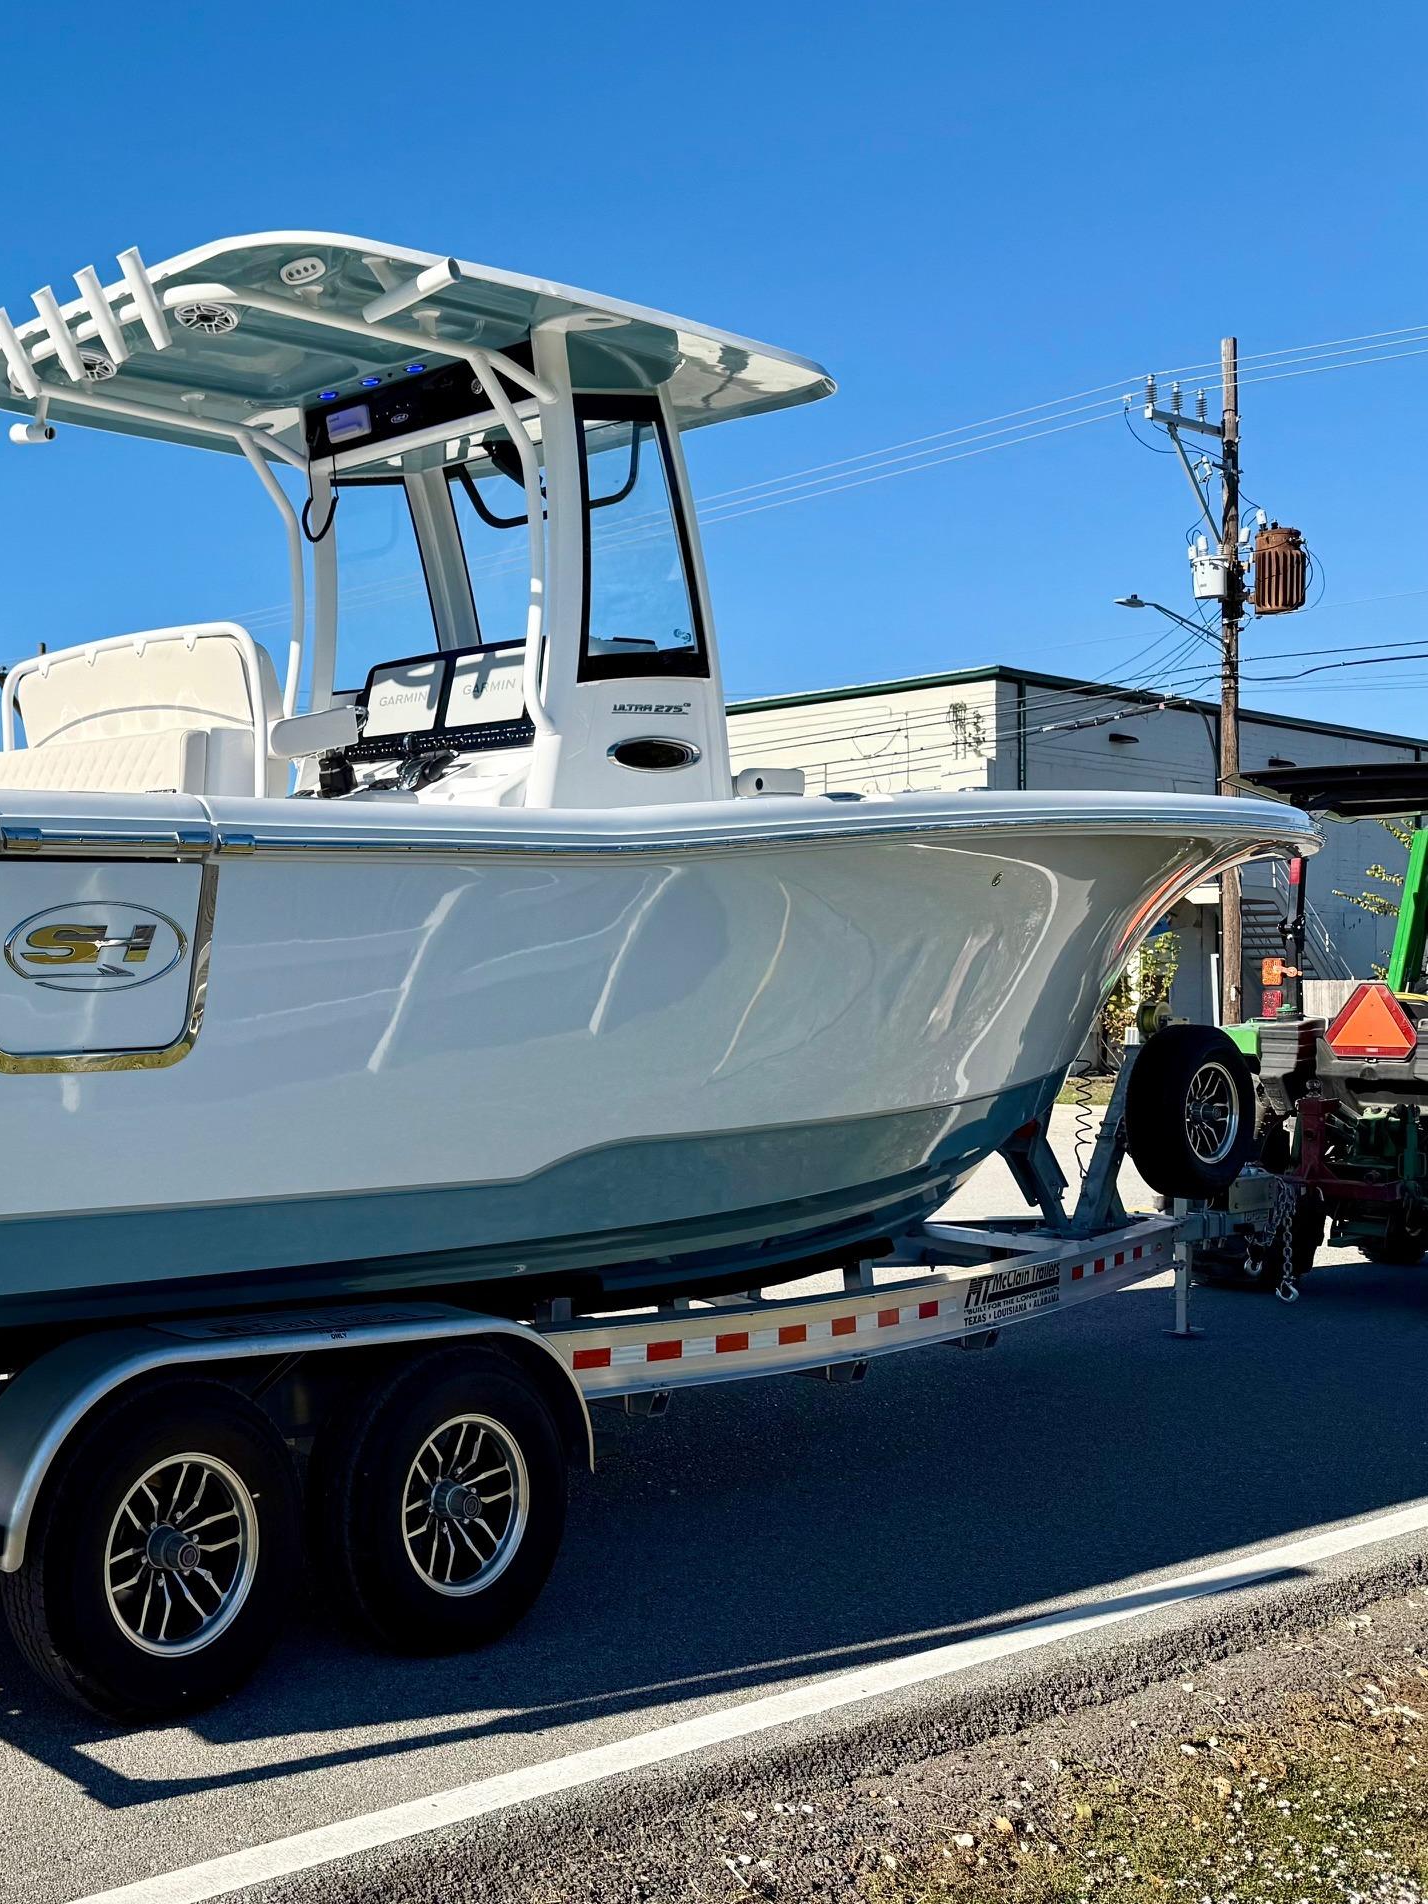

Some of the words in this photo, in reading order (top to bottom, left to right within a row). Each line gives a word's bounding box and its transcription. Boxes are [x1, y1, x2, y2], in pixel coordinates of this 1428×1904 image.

[463, 679, 516, 696] GARMIN
[379, 691, 428, 707] GARMIN
[613, 704, 652, 712] ULTRA
[654, 704, 683, 713] 275
[992, 1269, 1030, 1291] McClain
[1031, 1262, 1060, 1282] Trailers
[988, 1301, 1002, 1310] FOR
[1003, 1298, 1015, 1307] THE
[1016, 1292, 1038, 1303] LONG
[964, 1313, 987, 1327] TEXAS
[993, 1305, 1028, 1319] LOUISIANA
[1033, 1293, 1060, 1308] ALABAMA
